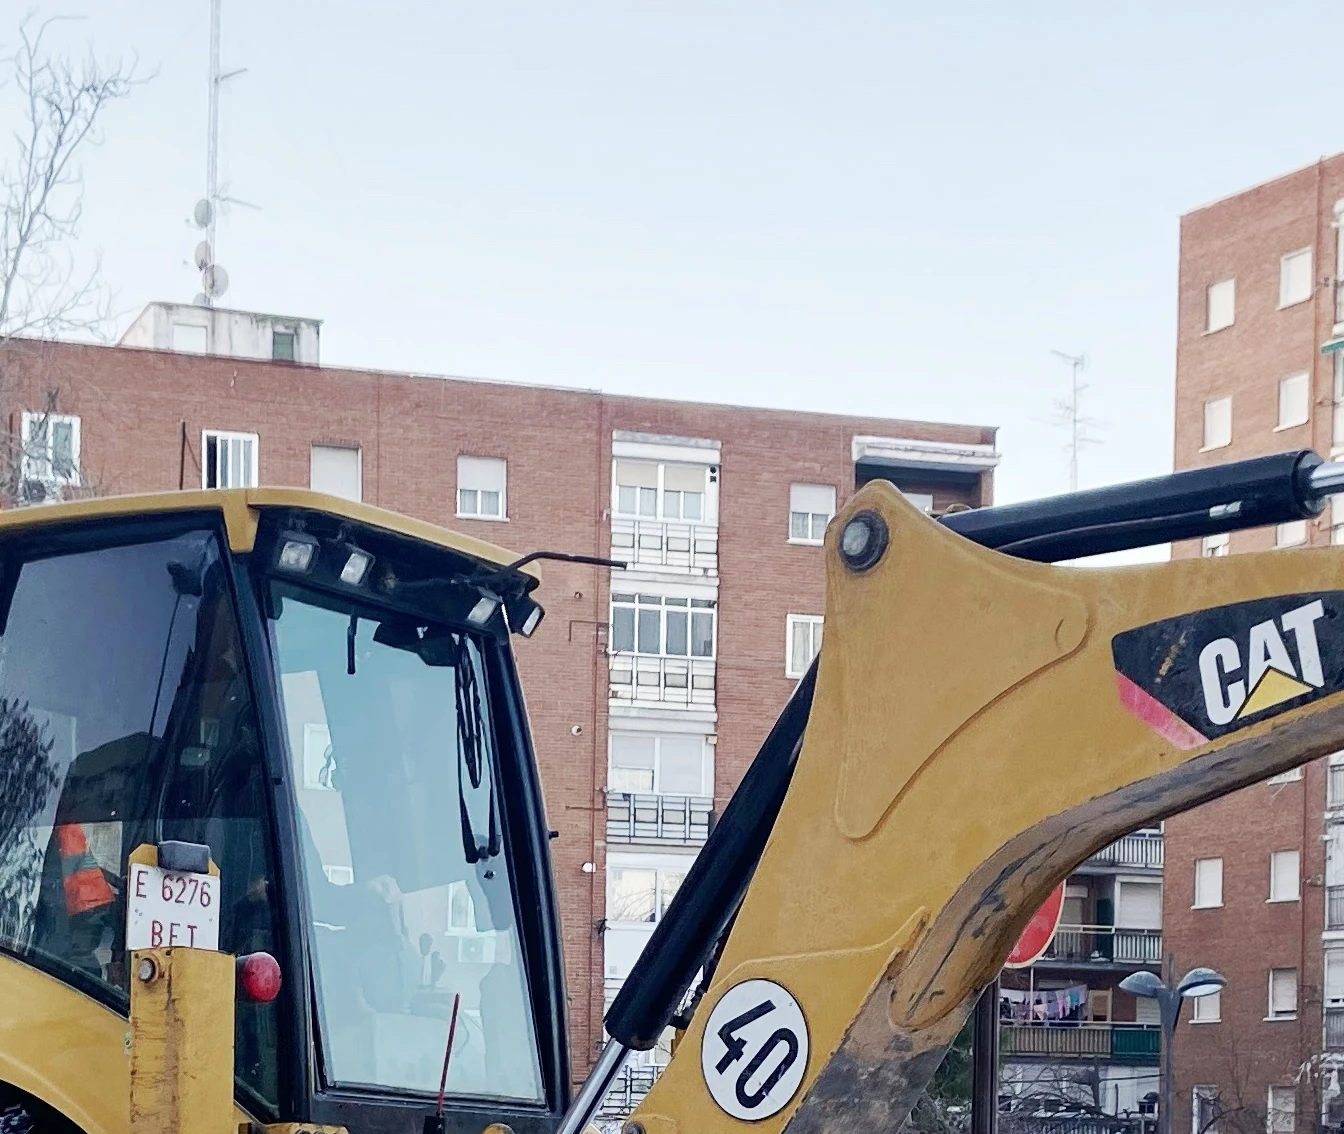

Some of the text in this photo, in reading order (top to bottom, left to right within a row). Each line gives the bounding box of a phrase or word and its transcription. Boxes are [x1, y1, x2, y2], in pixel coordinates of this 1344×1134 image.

[1198, 599, 1325, 726] CAT
[136, 870, 211, 907] E 6276
[714, 999, 799, 1109] 40
